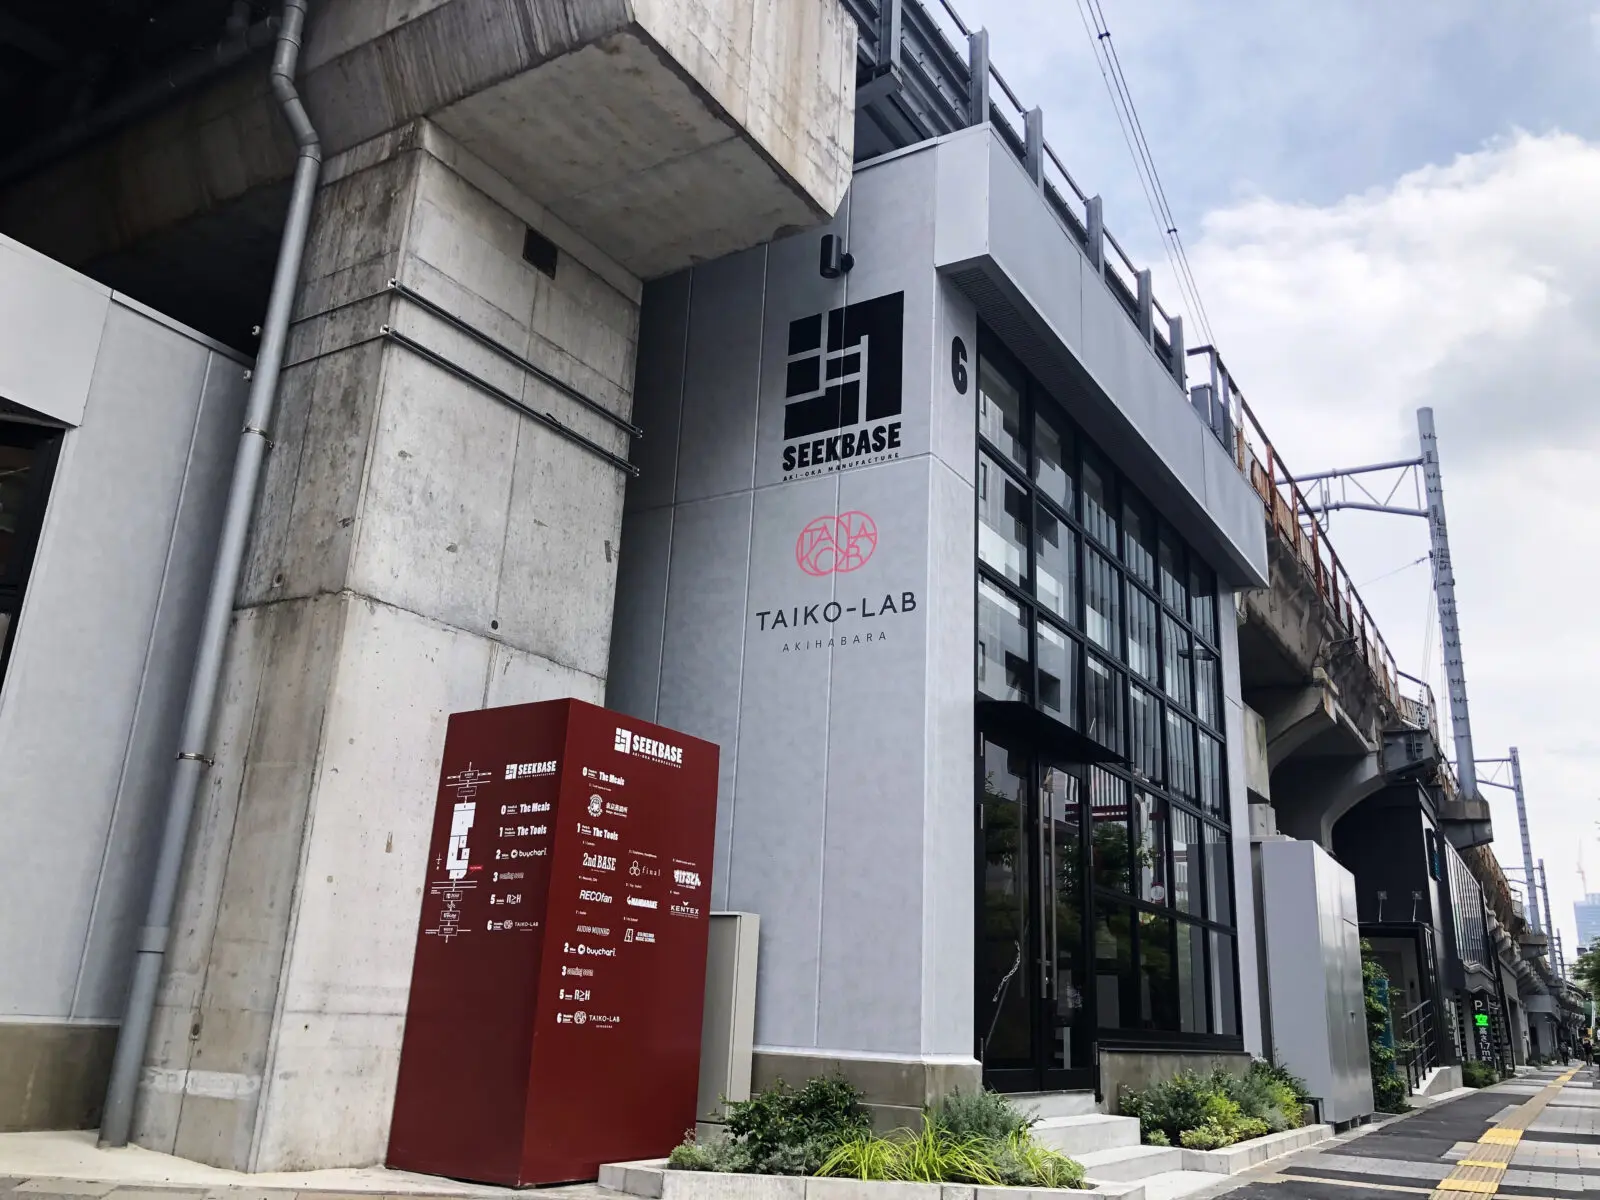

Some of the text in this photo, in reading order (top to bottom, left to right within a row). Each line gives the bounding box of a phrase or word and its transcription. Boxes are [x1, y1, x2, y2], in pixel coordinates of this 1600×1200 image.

[951, 335, 968, 395] 6
[782, 421, 901, 471] SEEKBASE
[782, 453, 899, 481] AKI-OKA MANUFACTURE
[756, 591, 917, 631] TAIKO-LAB
[783, 631, 886, 652] AKIHABARA
[632, 734, 683, 764] SEEKBASE
[517, 760, 557, 775] SEEKBASE
[582, 766, 588, 777] 0
[599, 771, 609, 782] The
[609, 774, 625, 786] Meals
[500, 804, 507, 815] 0
[520, 803, 531, 814] The
[531, 802, 551, 812] Meals
[499, 827, 504, 837] 1
[517, 826, 529, 836] The
[530, 824, 547, 835] Tools
[577, 822, 581, 833] 1
[593, 827, 603, 837] The
[604, 830, 618, 841] Tools
[495, 848, 501, 860] 2
[582, 852, 617, 871] 2nd BASE
[493, 871, 498, 882] 3
[642, 866, 661, 876] final
[490, 893, 496, 905] 5
[579, 889, 613, 904] RECOfan
[670, 904, 700, 915] KENTEX
[487, 919, 493, 931] 6
[563, 942, 569, 953] 2
[561, 965, 567, 976] 3
[559, 989, 565, 1000] 5
[1474, 1000, 1483, 1011] P
[556, 1012, 562, 1024] 6
[589, 1014, 620, 1023] TAIKO-LAB
